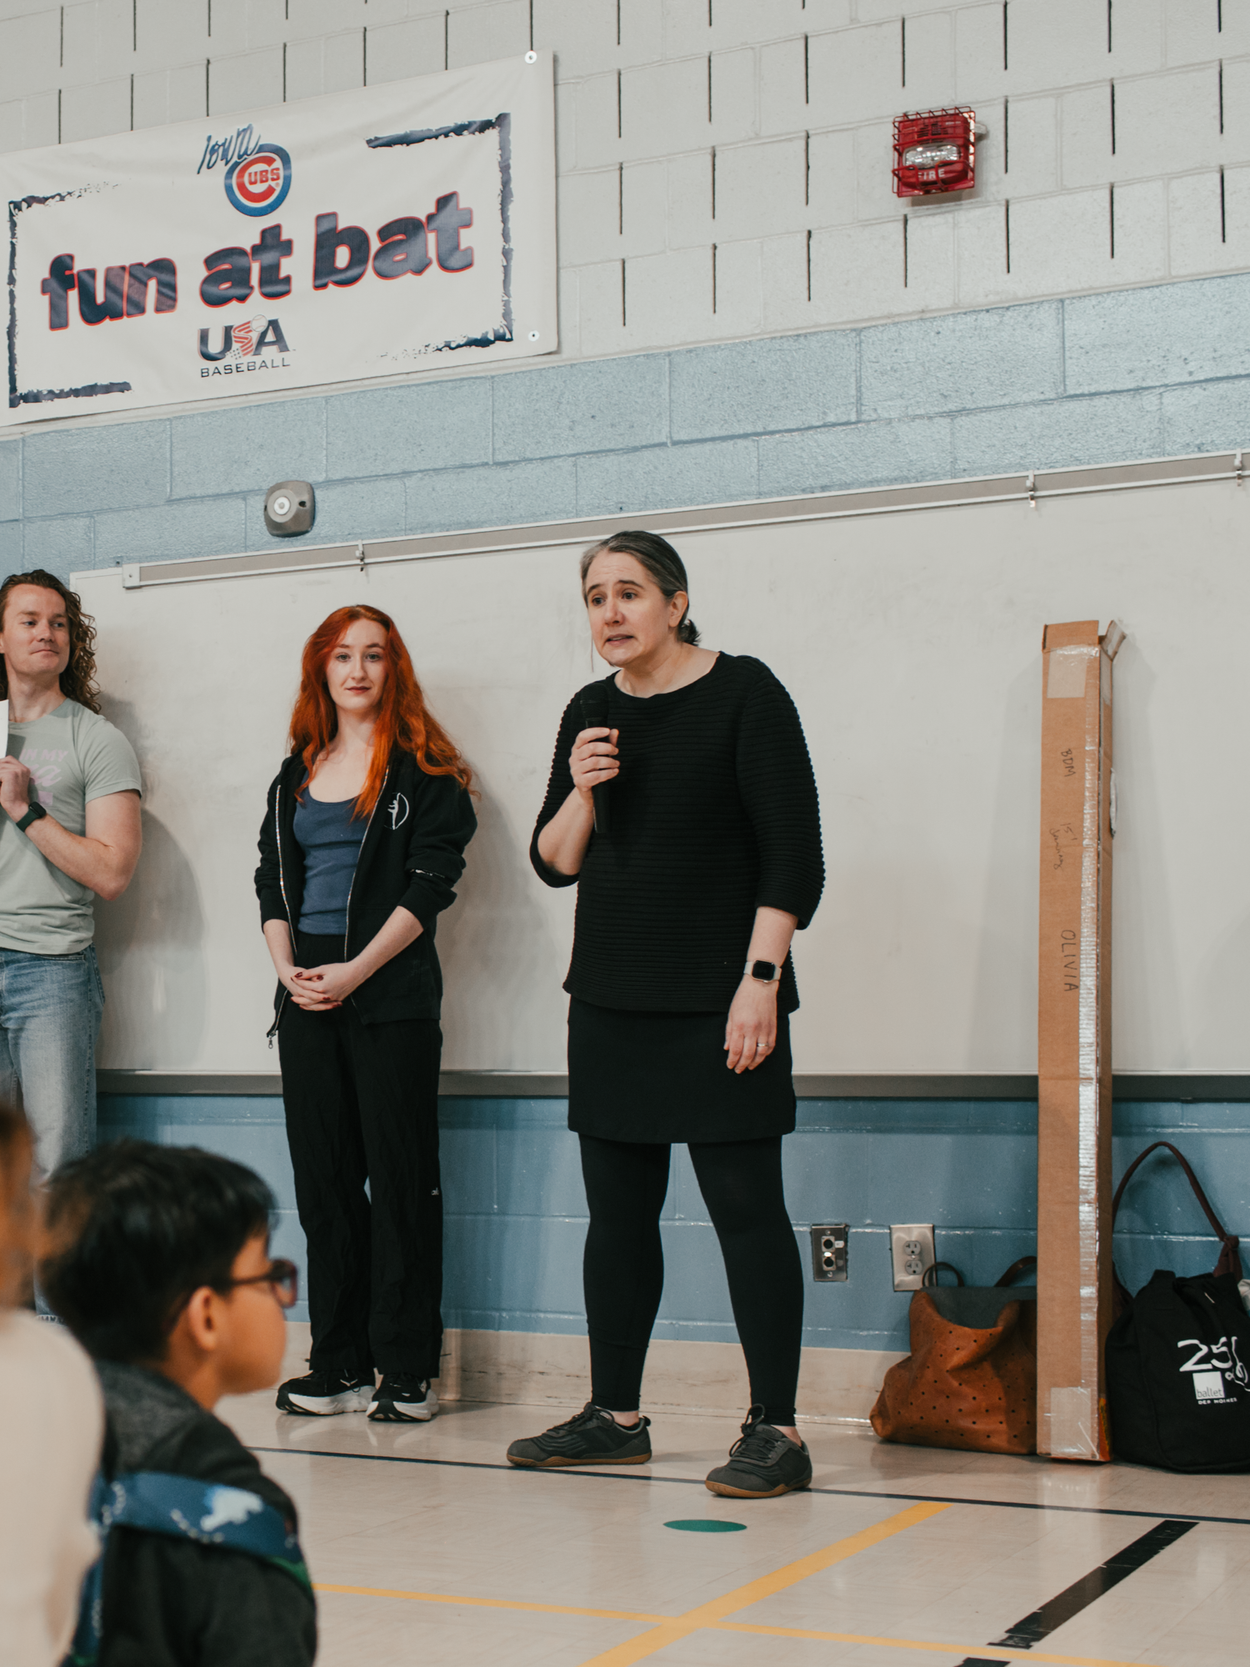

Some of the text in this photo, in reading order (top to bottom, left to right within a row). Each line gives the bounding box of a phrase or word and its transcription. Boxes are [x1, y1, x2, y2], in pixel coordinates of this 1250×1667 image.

[41, 191, 474, 331] fun at bat
[197, 316, 290, 361] USA
[200, 358, 291, 378] BASEBALL
[19, 749, 68, 761] IN MY
[1061, 929, 1079, 992] OLIVIA
[1197, 1387, 1223, 1398] ballet
